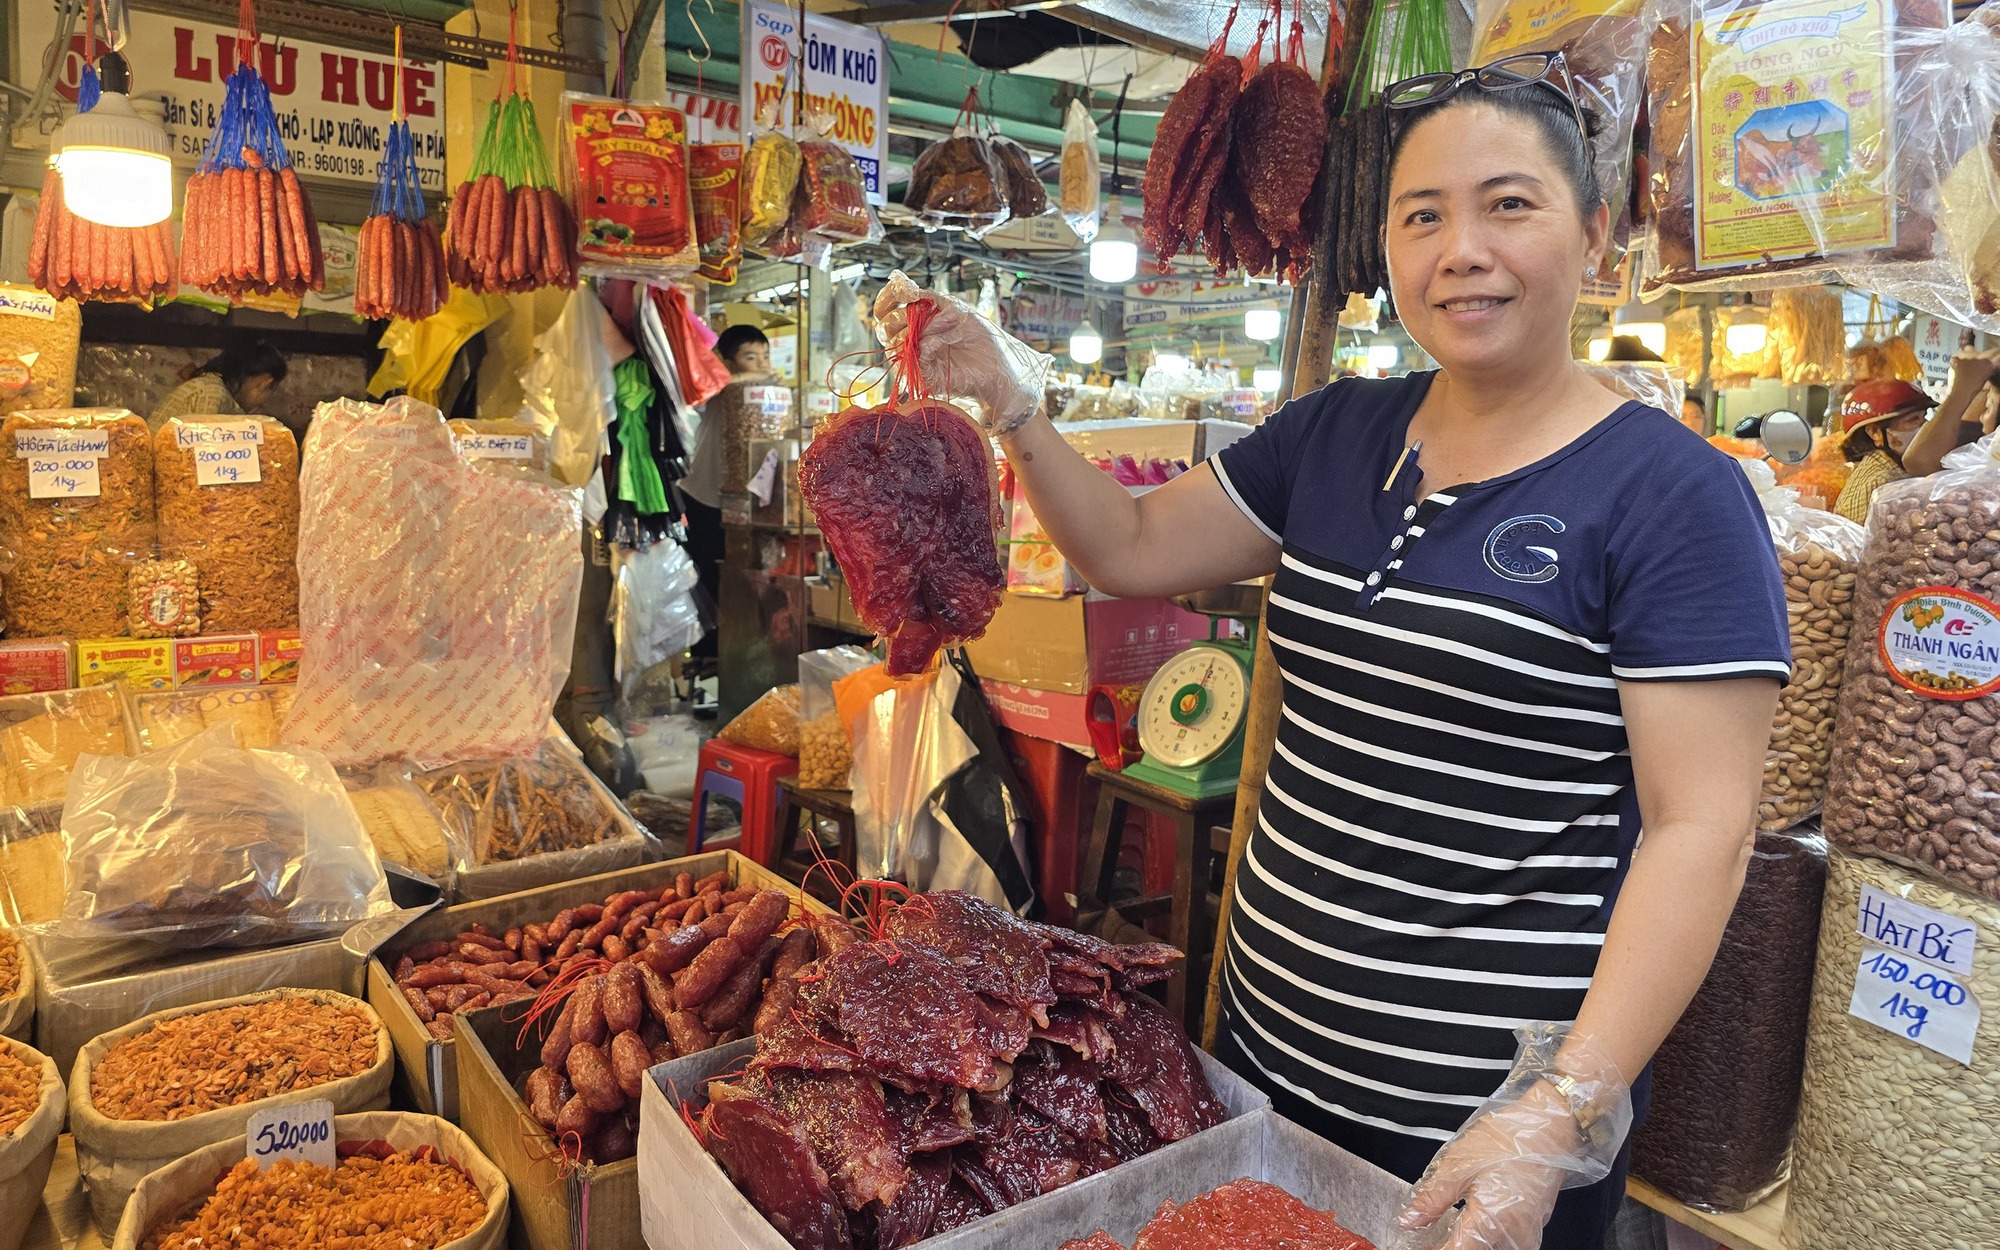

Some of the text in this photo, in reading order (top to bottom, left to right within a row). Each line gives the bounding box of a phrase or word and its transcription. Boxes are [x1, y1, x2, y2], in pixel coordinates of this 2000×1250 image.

[755, 12, 793, 36] Sạp
[764, 42, 784, 65] 07
[842, 48, 876, 85] KHÔ
[314, 153, 364, 175] 9600198
[1734, 206, 1763, 217] THƠM
[1893, 631, 1942, 655] THANH
[1947, 640, 1999, 664] NGÂN
[1862, 952, 1966, 1006] 150.000
[1880, 993, 1929, 1038] 1kg
